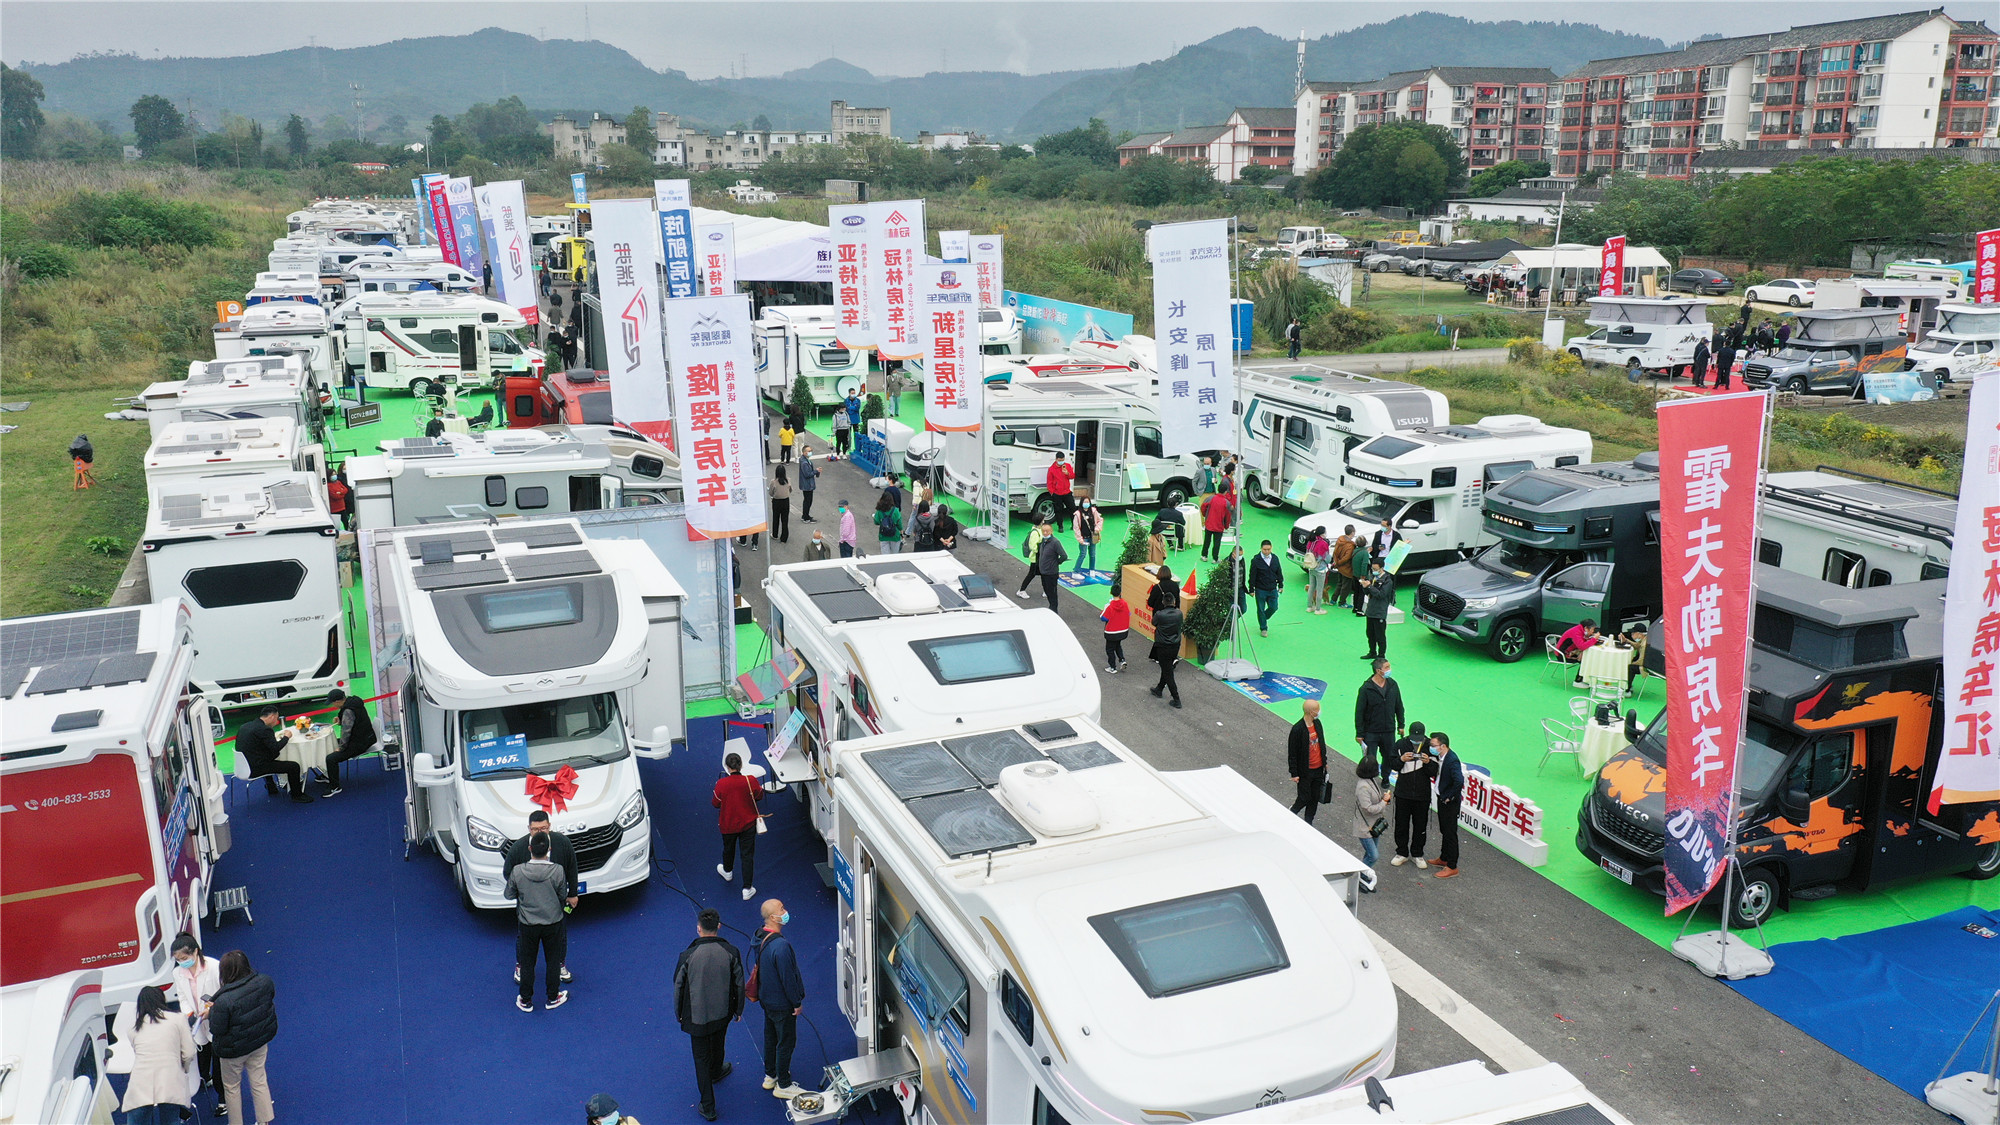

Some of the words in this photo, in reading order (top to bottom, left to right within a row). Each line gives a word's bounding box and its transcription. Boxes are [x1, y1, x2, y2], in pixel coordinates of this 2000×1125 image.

[1396, 416, 1429, 426] ISUZU
[1354, 471, 1380, 482] CHANGAN
[1491, 513, 1524, 527] CHANGAN
[41, 788, 111, 808] 400-833-3533
[1615, 799, 1650, 822] IVECO
[1457, 811, 1479, 830] FULO
[1481, 823, 1493, 838] RV
